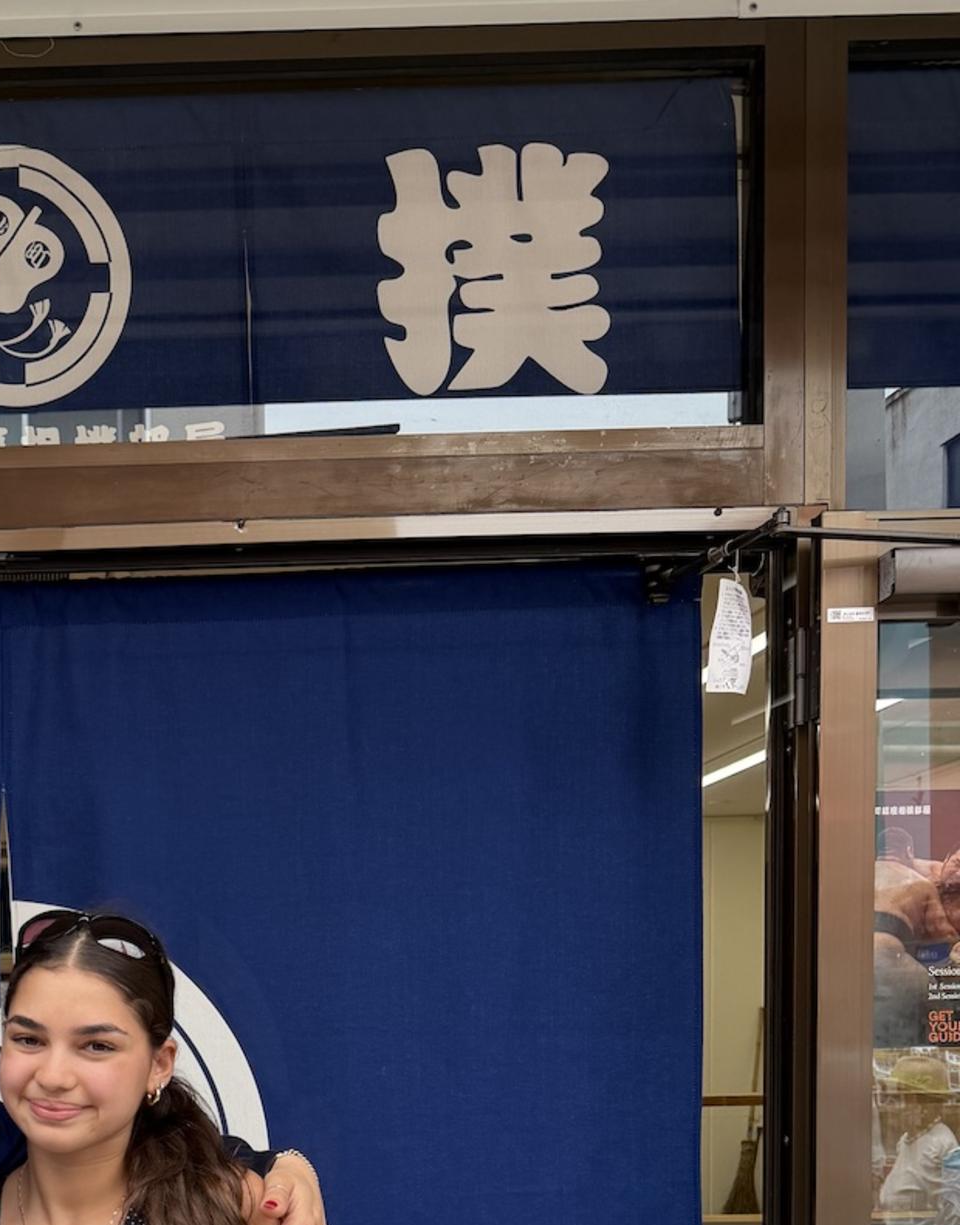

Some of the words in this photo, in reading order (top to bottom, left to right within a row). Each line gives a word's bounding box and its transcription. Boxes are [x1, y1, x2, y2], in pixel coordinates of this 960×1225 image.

[376, 142, 611, 396] 撲
[928, 1010, 954, 1021] GET
[928, 1021, 960, 1032] YOU
